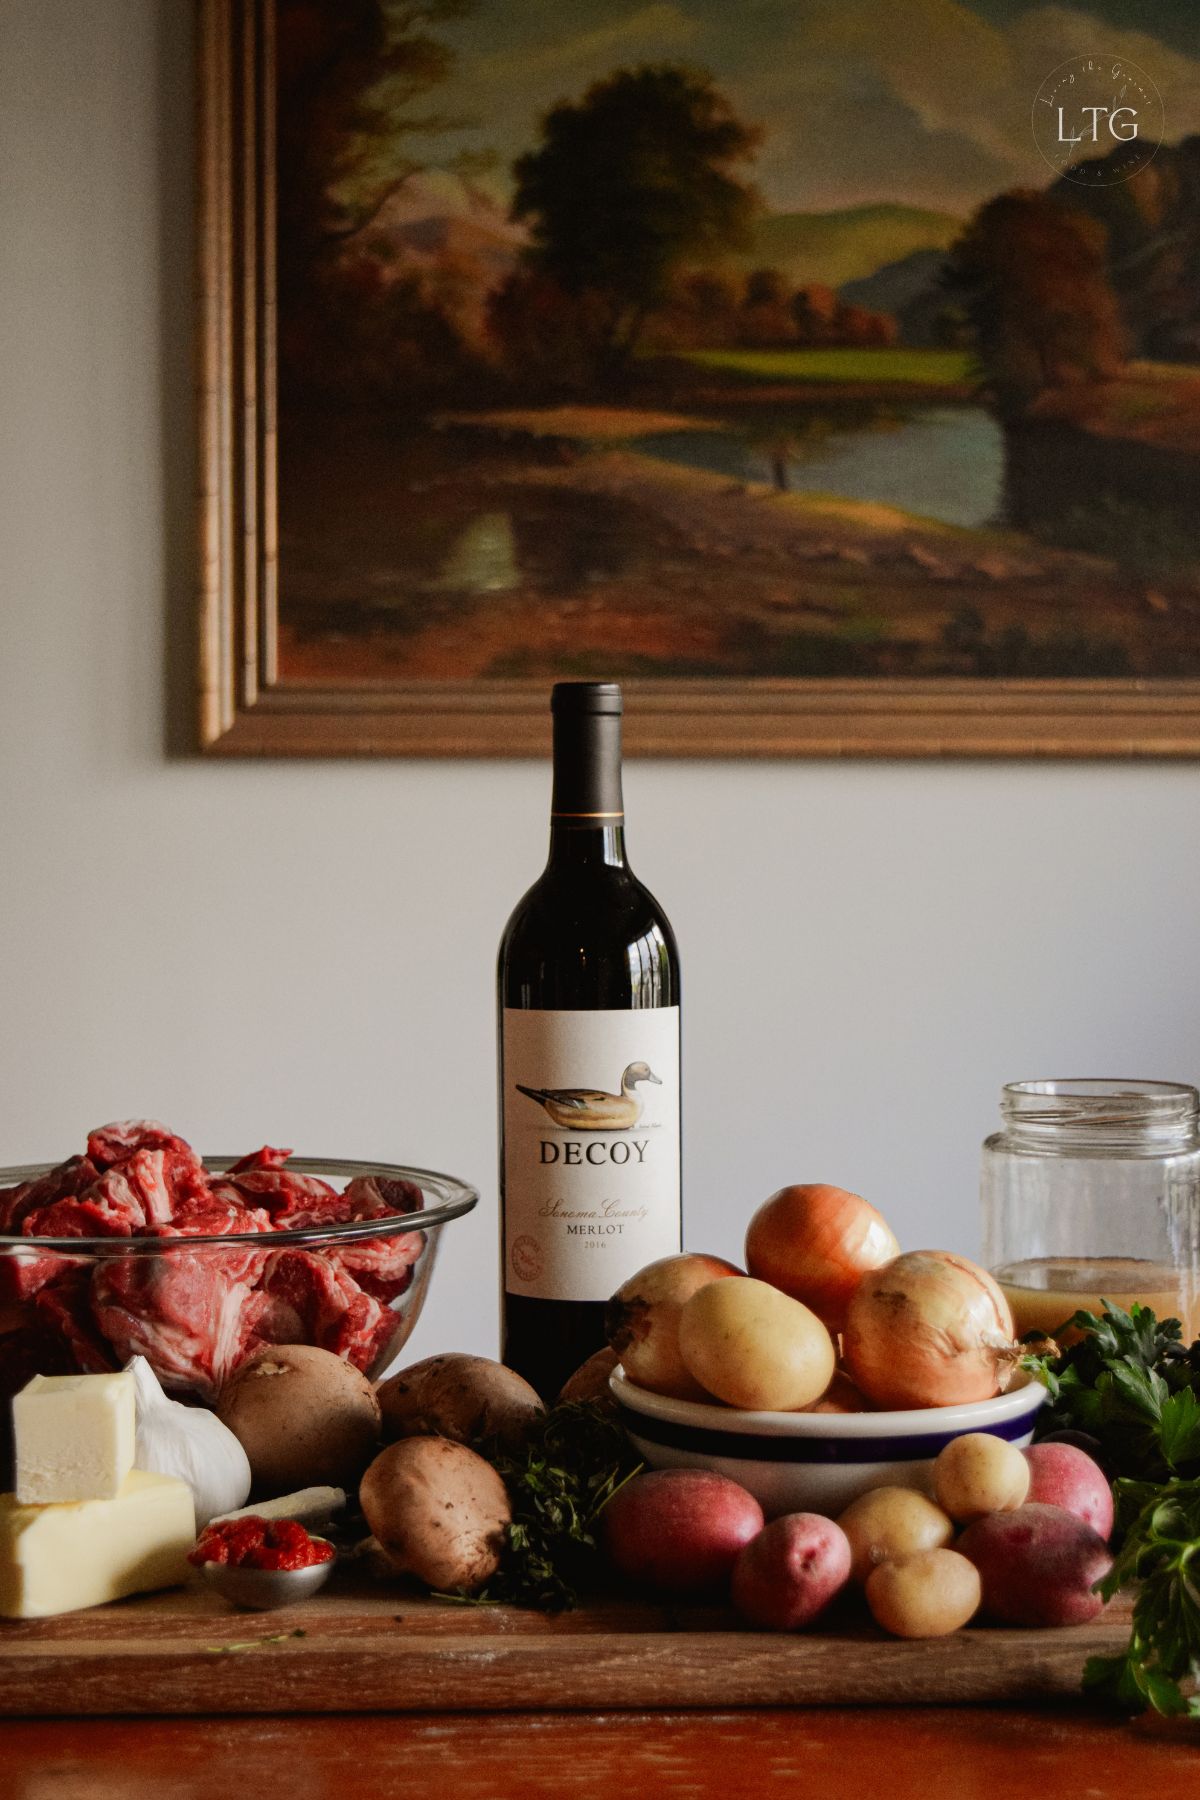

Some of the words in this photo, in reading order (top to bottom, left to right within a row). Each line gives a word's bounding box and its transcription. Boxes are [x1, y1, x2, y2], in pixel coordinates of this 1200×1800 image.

[540, 1140, 649, 1165] DECOY
[538, 1198, 597, 1218] Sonoma
[598, 1198, 648, 1221] County
[567, 1225, 624, 1235] MERLOT
[584, 1241, 606, 1249] 2016
